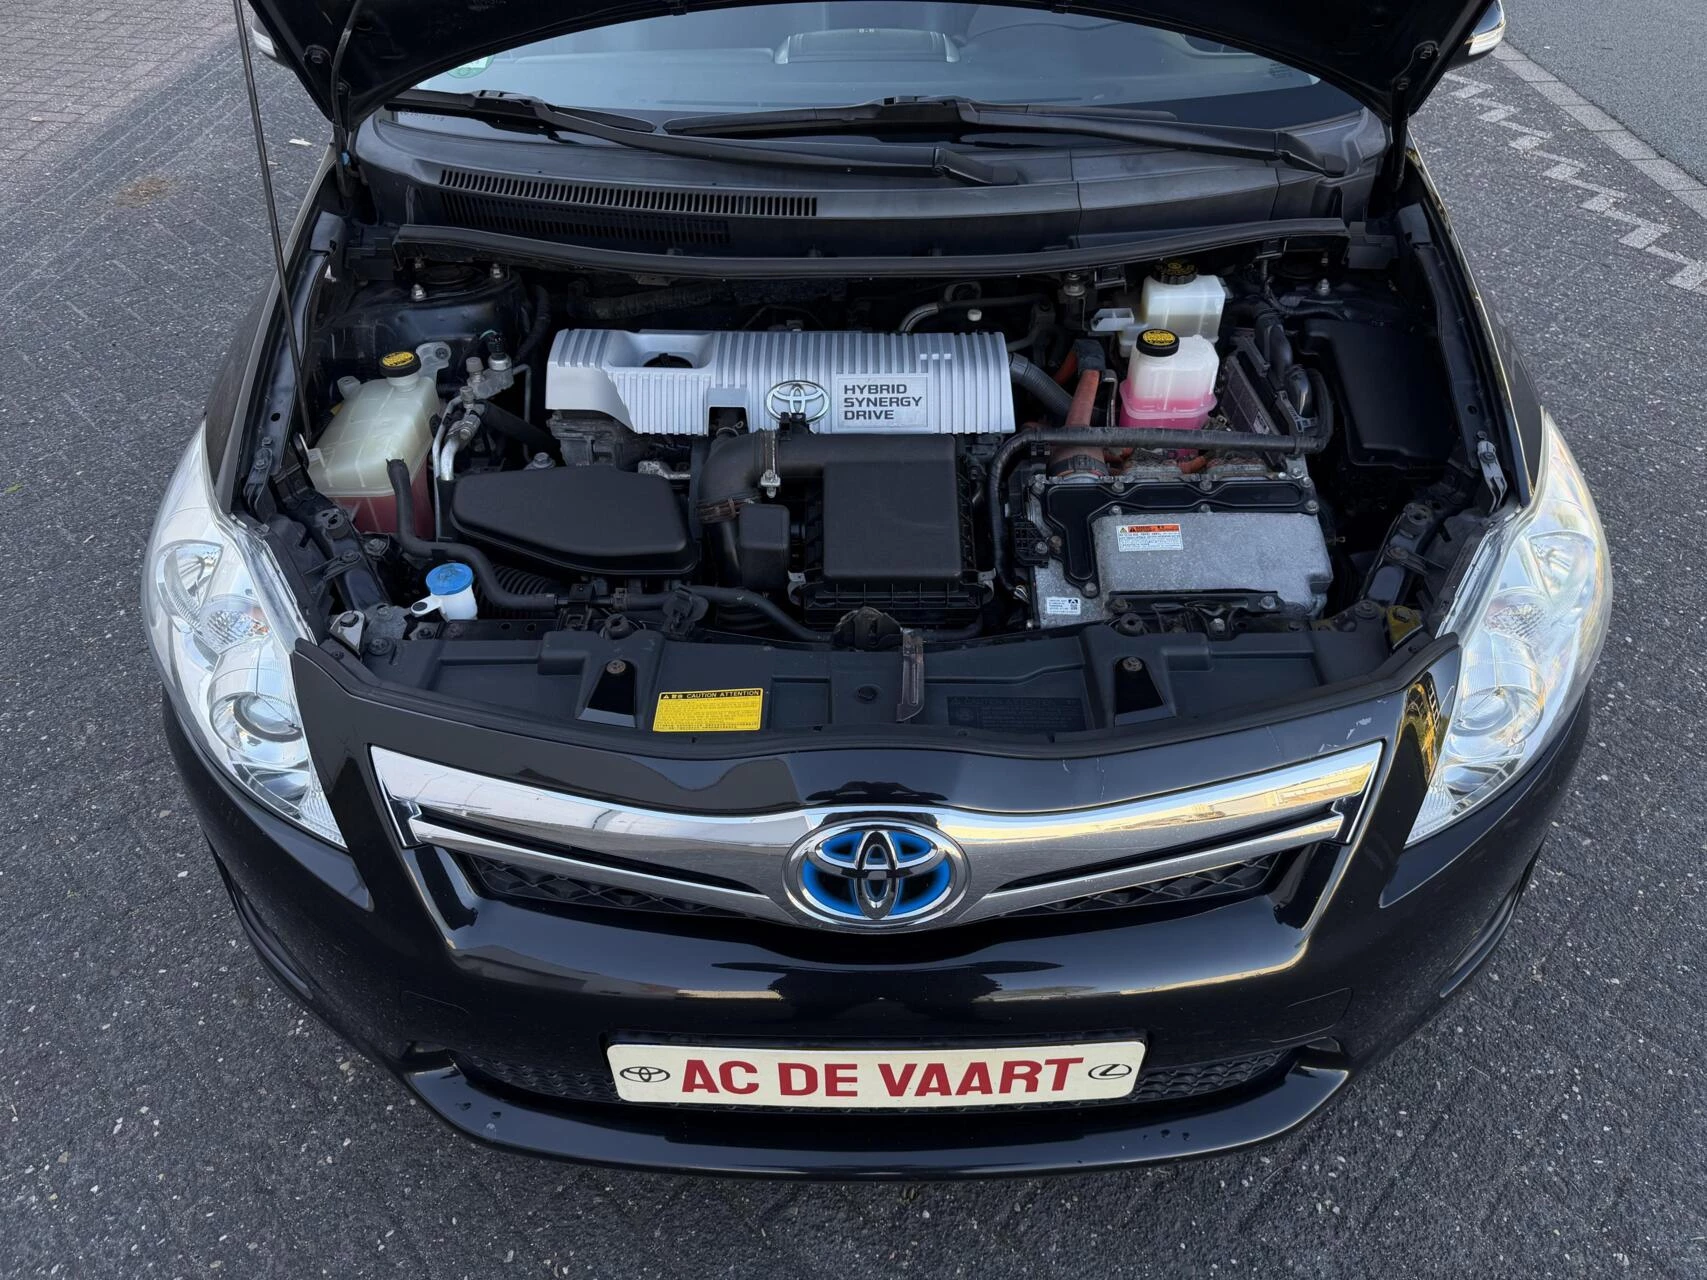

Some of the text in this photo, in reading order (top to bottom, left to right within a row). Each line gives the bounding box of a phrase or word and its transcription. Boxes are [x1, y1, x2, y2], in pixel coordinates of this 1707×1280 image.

[843, 384, 907, 395] HYBRID
[843, 396, 922, 408] SYNERGY
[843, 409, 894, 421] DRIVE
[682, 1057, 1084, 1097] AC DE VAART
